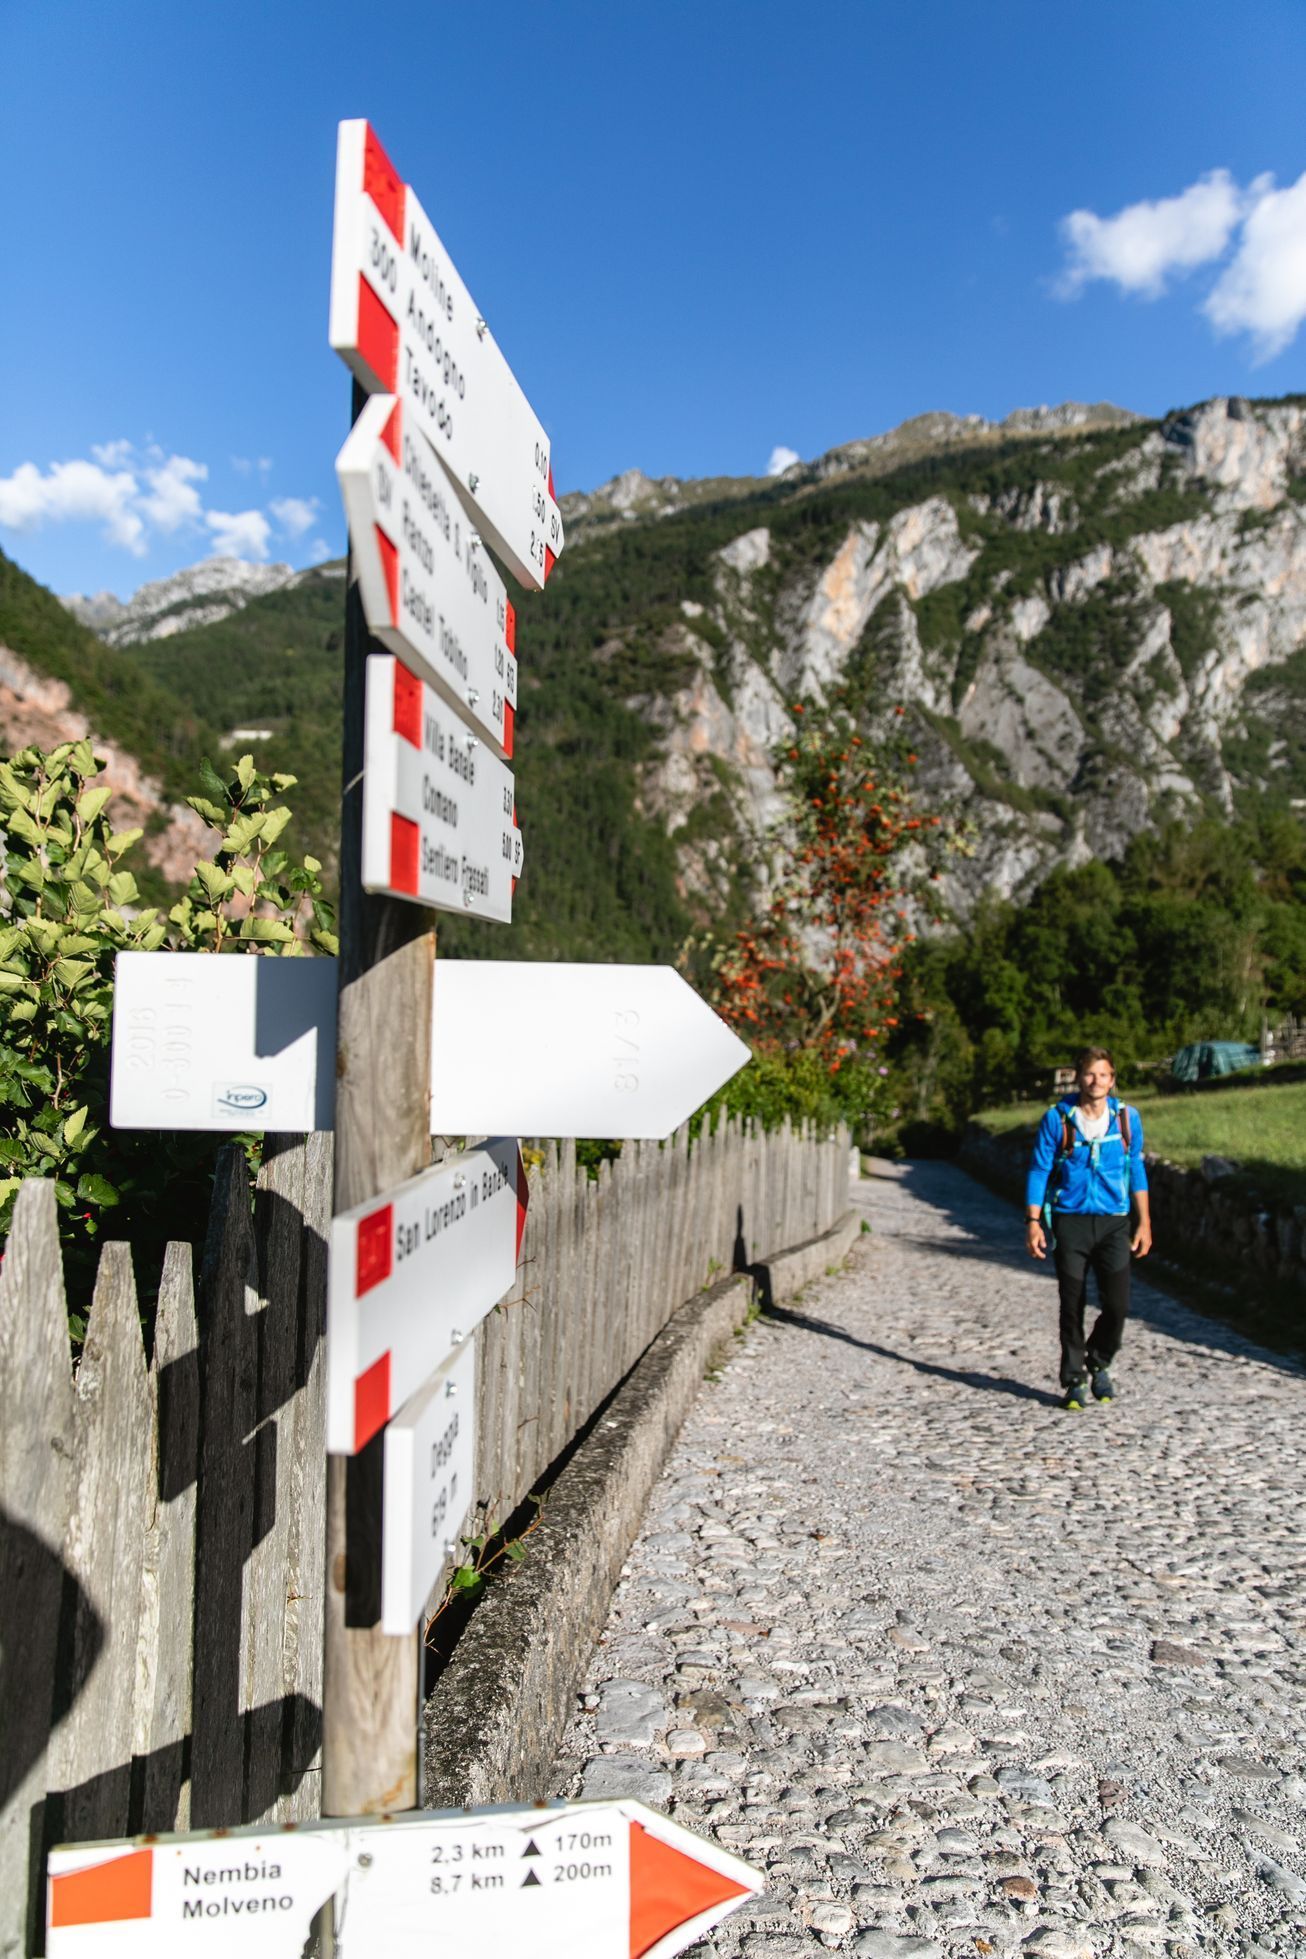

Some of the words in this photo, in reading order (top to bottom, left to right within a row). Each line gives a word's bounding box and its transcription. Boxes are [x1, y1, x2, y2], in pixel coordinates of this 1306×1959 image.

[411, 222, 453, 322] Moline
[371, 227, 397, 293] 300
[406, 288, 465, 400] Andogno
[406, 346, 452, 440] Tavodo
[423, 773, 458, 829] Comano
[395, 1221, 421, 1262] San
[425, 1191, 466, 1242] Lorenzo
[470, 1181, 479, 1209] in
[482, 1162, 509, 1201] Banale
[183, 1861, 282, 1887] Nembia
[472, 1842, 505, 1860] km
[555, 1833, 612, 1852] 170m
[471, 1872, 504, 1891] km
[553, 1863, 612, 1883] 200m
[182, 1894, 294, 1920] Molveno
